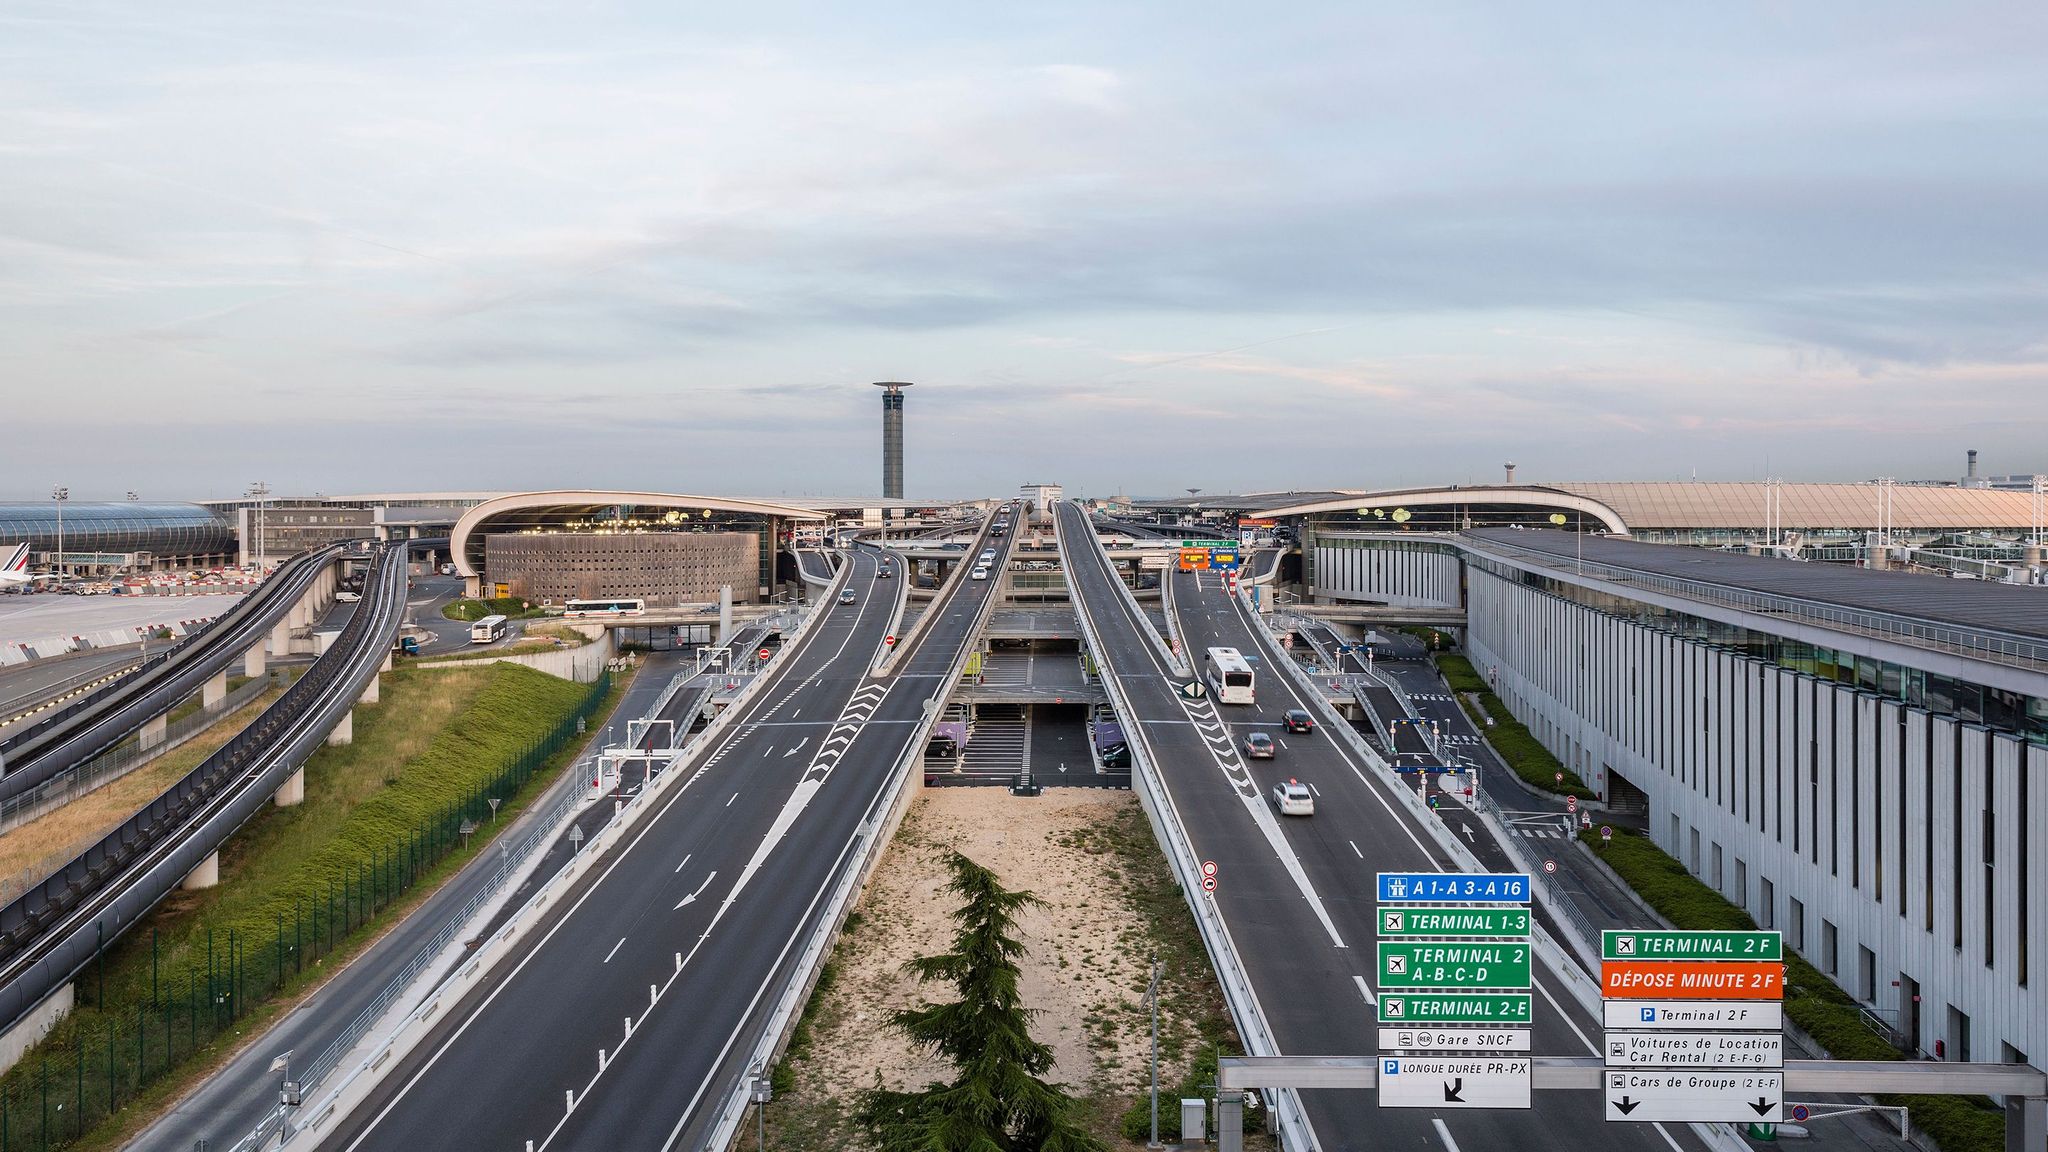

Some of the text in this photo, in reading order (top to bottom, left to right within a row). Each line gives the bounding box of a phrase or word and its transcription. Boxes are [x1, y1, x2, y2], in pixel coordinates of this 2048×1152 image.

[1411, 915, 1526, 929] TERMINAL 1-3
[1643, 938, 1733, 953] TERMINAL
[1413, 949, 1523, 963] TERMINAL 2
[1610, 970, 1675, 987] DÉPOSE
[1681, 974, 1744, 987] MINUTE
[1412, 1001, 1526, 1015] TERMINAL 2-E
[1661, 1010, 1720, 1020] Terminal
[1437, 1034, 1468, 1045] Gare
[1477, 1035, 1513, 1045] SNCF
[1631, 1037, 1778, 1049] Voitures de Location
[1630, 1052, 1653, 1062] Car
[1661, 1052, 1706, 1062] Rental
[1403, 1064, 1444, 1073] LONGUE
[1448, 1063, 1482, 1073] DURÉE
[1487, 1063, 1527, 1074] PR-PX
[1630, 1076, 1660, 1087] Cars
[1667, 1077, 1682, 1087] de
[1688, 1077, 1736, 1090] Groupe
